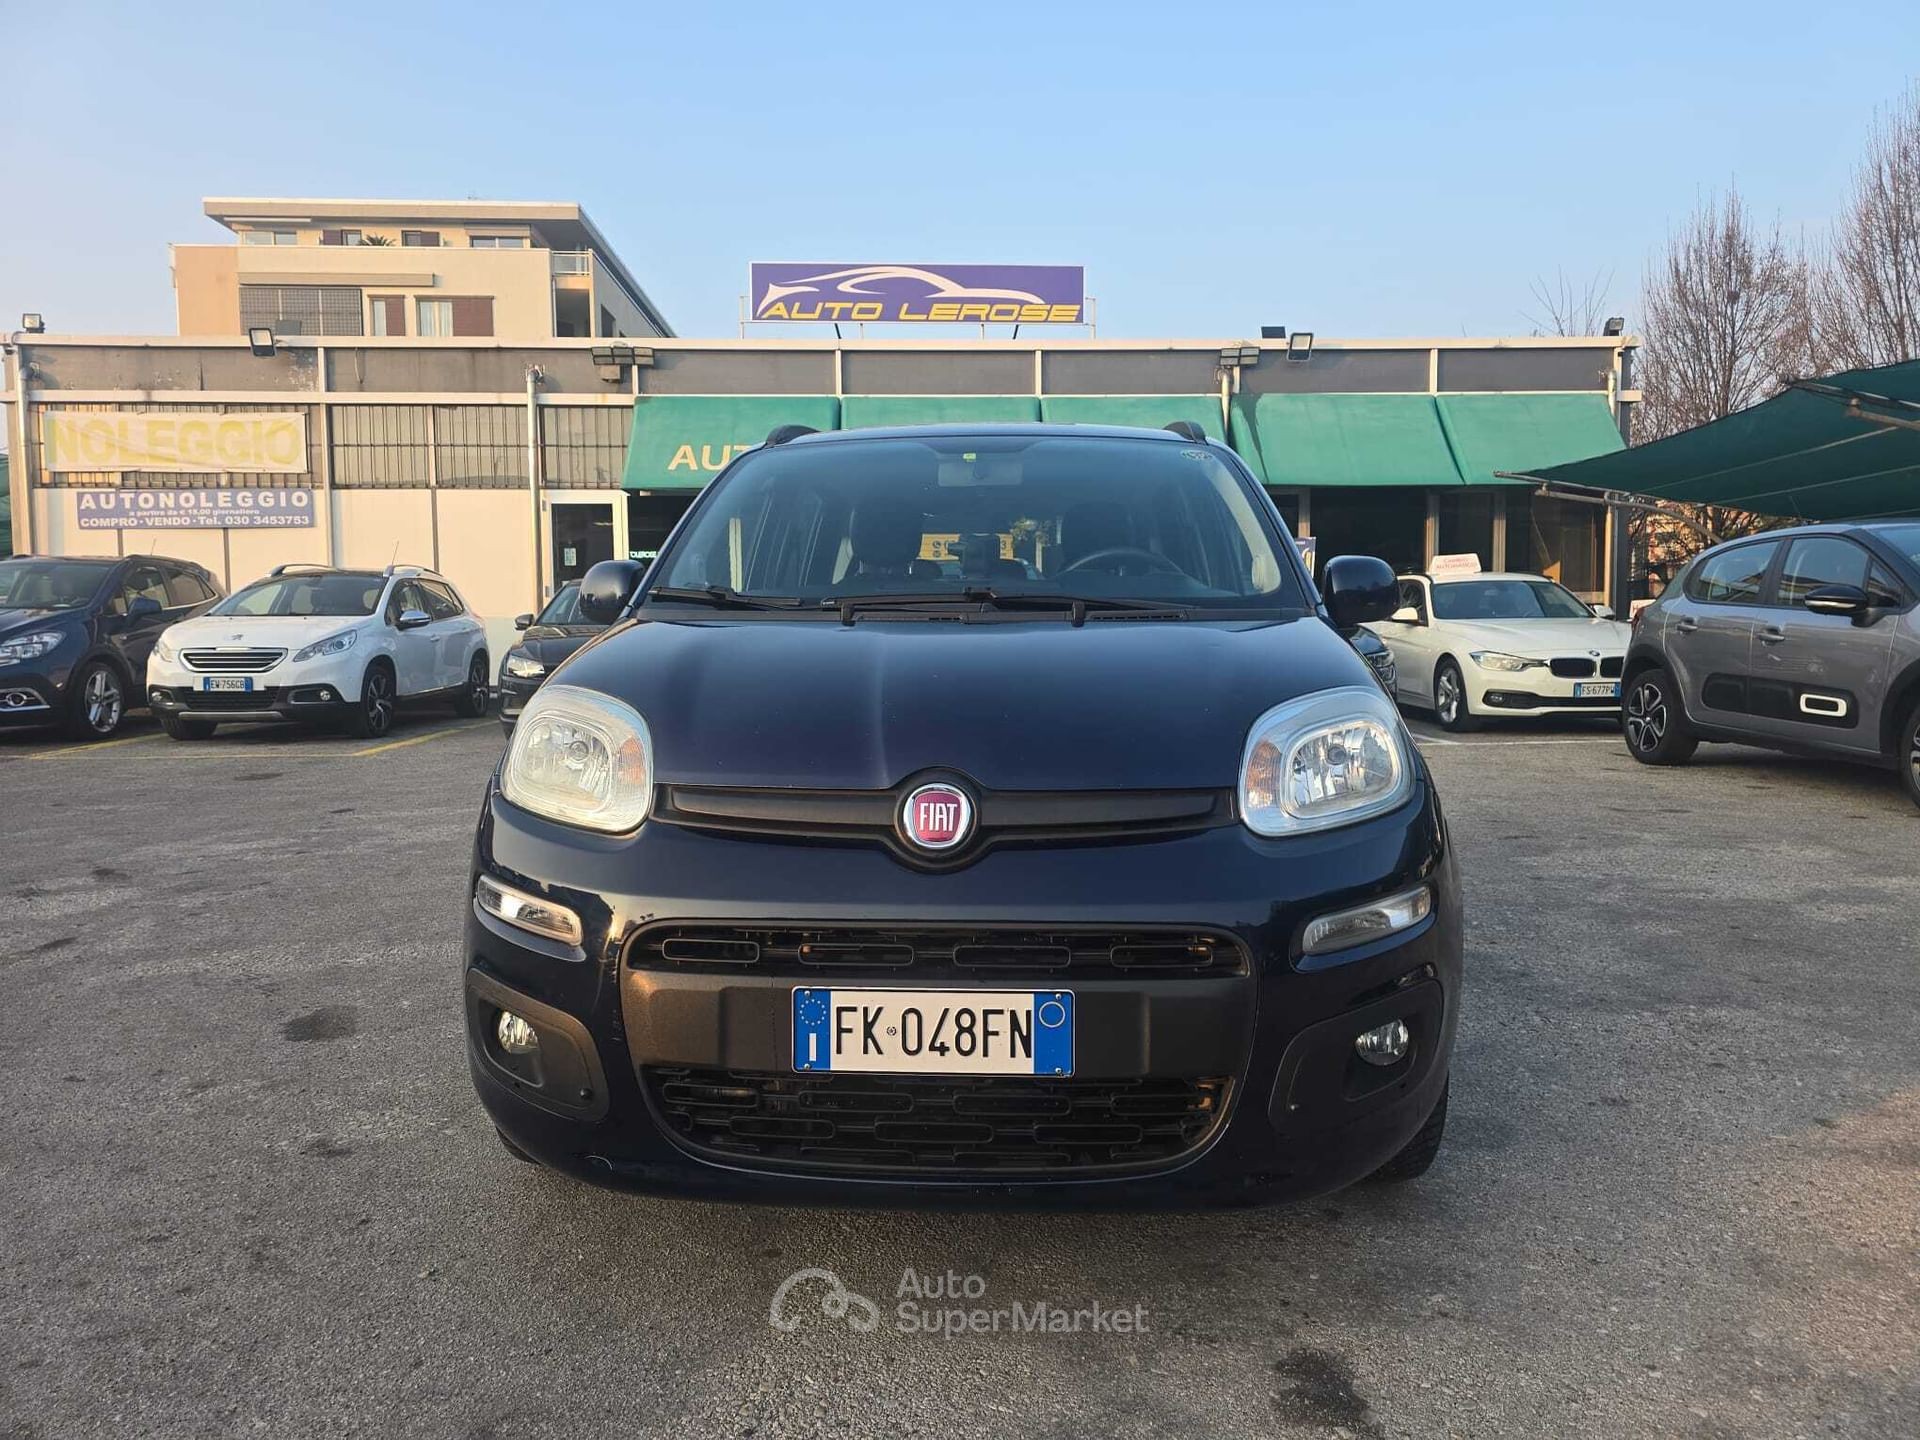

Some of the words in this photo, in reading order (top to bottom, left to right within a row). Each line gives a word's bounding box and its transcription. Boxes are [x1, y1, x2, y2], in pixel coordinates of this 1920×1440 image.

[760, 302, 884, 320] AUTO
[900, 302, 1081, 322] LEROSE
[54, 419, 300, 465] NOLEGGIO
[80, 491, 309, 510] AUTONOLEGGIO
[81, 518, 138, 527] COMPRO
[145, 517, 191, 526] VENDO
[198, 516, 221, 525] Tel.
[225, 515, 250, 525] 030
[254, 515, 310, 525] 3453753
[920, 803, 958, 832] FIAT
